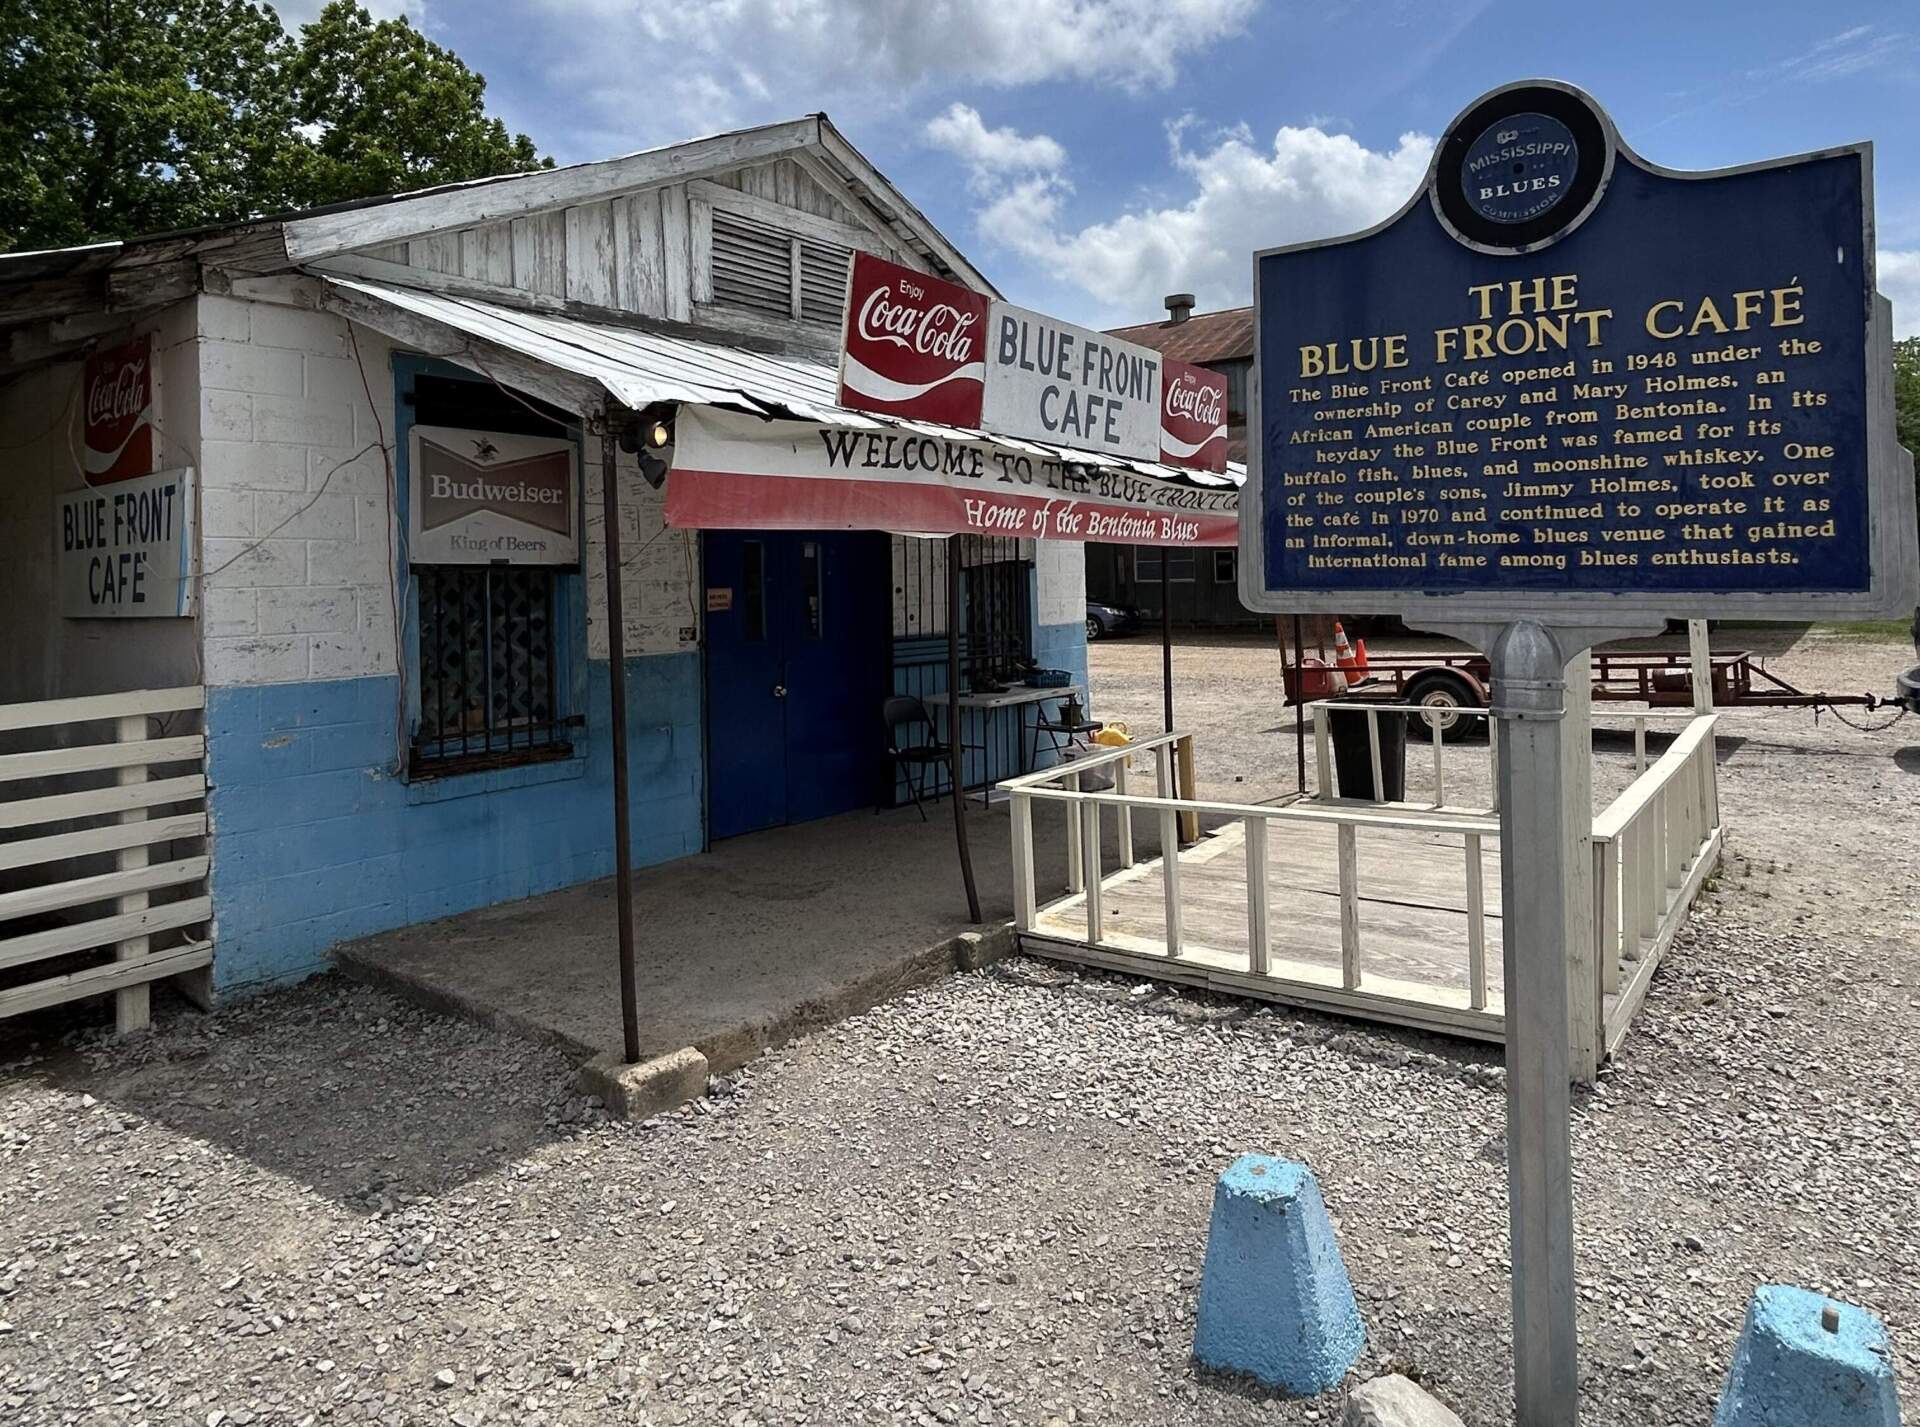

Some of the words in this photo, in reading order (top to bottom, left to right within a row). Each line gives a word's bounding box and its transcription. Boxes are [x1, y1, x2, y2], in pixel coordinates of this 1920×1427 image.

[1469, 142, 1570, 173] MISSISSIPPI
[1480, 174, 1561, 200] BLUES
[899, 279, 925, 301] Enjoy
[1468, 274, 1579, 319] THE
[1299, 334, 1409, 378] BLUE
[1434, 308, 1613, 364] FRONT
[1646, 276, 1805, 339] CAFÉ
[999, 314, 1074, 381] BLUE
[1083, 340, 1158, 403] FRONT
[1289, 388, 1322, 402] The
[1331, 384, 1369, 399] Blue
[1380, 376, 1432, 394] Front
[1445, 370, 1489, 388] Café
[1502, 361, 1575, 384] opened
[1592, 358, 1613, 374] in
[1627, 352, 1677, 371] 1948
[1692, 345, 1762, 365] under
[1779, 339, 1822, 356] the
[1040, 385, 1123, 444] CAFE
[1289, 428, 1353, 445] African
[1365, 421, 1453, 438] American
[1466, 414, 1532, 433] couple
[1545, 408, 1598, 426] from
[1616, 399, 1727, 420] Bentonia.
[1748, 394, 1772, 410] In
[1792, 390, 1828, 406] its
[1314, 402, 1401, 422] ownership
[1415, 398, 1435, 413] of
[1447, 392, 1507, 410] Carey
[1520, 387, 1558, 404] and
[1573, 384, 1628, 399] Mary
[1646, 374, 1739, 393] Holmes,
[1756, 370, 1785, 384] an
[1316, 447, 1381, 463] heyday
[1393, 443, 1425, 458] the
[1437, 440, 1479, 456] Blue
[1491, 433, 1548, 451] Front
[1562, 433, 1598, 447] was
[1613, 425, 1684, 445] famed
[1697, 423, 1734, 439] for
[1747, 420, 1782, 436] its
[819, 428, 985, 479] WELCOME
[993, 450, 1033, 485] TO
[1099, 471, 1153, 504] BLUE
[1150, 485, 1226, 511] FRONT
[1284, 470, 1346, 486] buffalo
[1357, 467, 1399, 482] fish,
[1412, 464, 1469, 479] blues,
[1483, 460, 1519, 476] and
[1533, 453, 1649, 474] moonshine
[1664, 448, 1765, 465] whiskey.
[1783, 443, 1835, 460] One
[430, 474, 563, 504] Budweiser
[1287, 492, 1306, 507] of
[1316, 491, 1344, 505] the
[1355, 487, 1425, 505] couple's
[1440, 487, 1487, 500] sons,
[1503, 481, 1574, 498] Jimmy
[1590, 477, 1679, 494] Holmes,
[1700, 471, 1755, 489] took
[1772, 471, 1830, 486] over
[63, 498, 107, 552] BLUE
[114, 484, 176, 547] FRONT
[964, 498, 1027, 530] Home
[1032, 499, 1056, 539] of
[1056, 500, 1084, 535] the
[1087, 509, 1156, 541] Bentonia
[1160, 516, 1199, 541] Blues
[1286, 513, 1314, 527] the
[1323, 510, 1360, 526] café
[1372, 511, 1390, 525] in
[1401, 508, 1439, 524] 1970
[1451, 507, 1487, 522] and
[1500, 502, 1604, 519] continued
[1617, 501, 1641, 517] to
[1655, 498, 1747, 519] operate
[1763, 497, 1785, 513] it
[1803, 498, 1831, 512] as
[450, 534, 488, 552] King
[490, 536, 504, 550] of
[506, 535, 547, 551] Beers
[1285, 536, 1305, 549] an
[1313, 533, 1393, 548] informal,
[1406, 530, 1521, 545] down-home
[1533, 527, 1589, 543] blues
[1601, 528, 1666, 542] venue
[1682, 523, 1734, 540] that
[1747, 519, 1836, 542] gained
[1308, 552, 1427, 568] international
[1439, 553, 1487, 567] fame
[1500, 553, 1566, 570] among
[1580, 550, 1639, 566] blues
[1652, 547, 1799, 565] enthusiasts.
